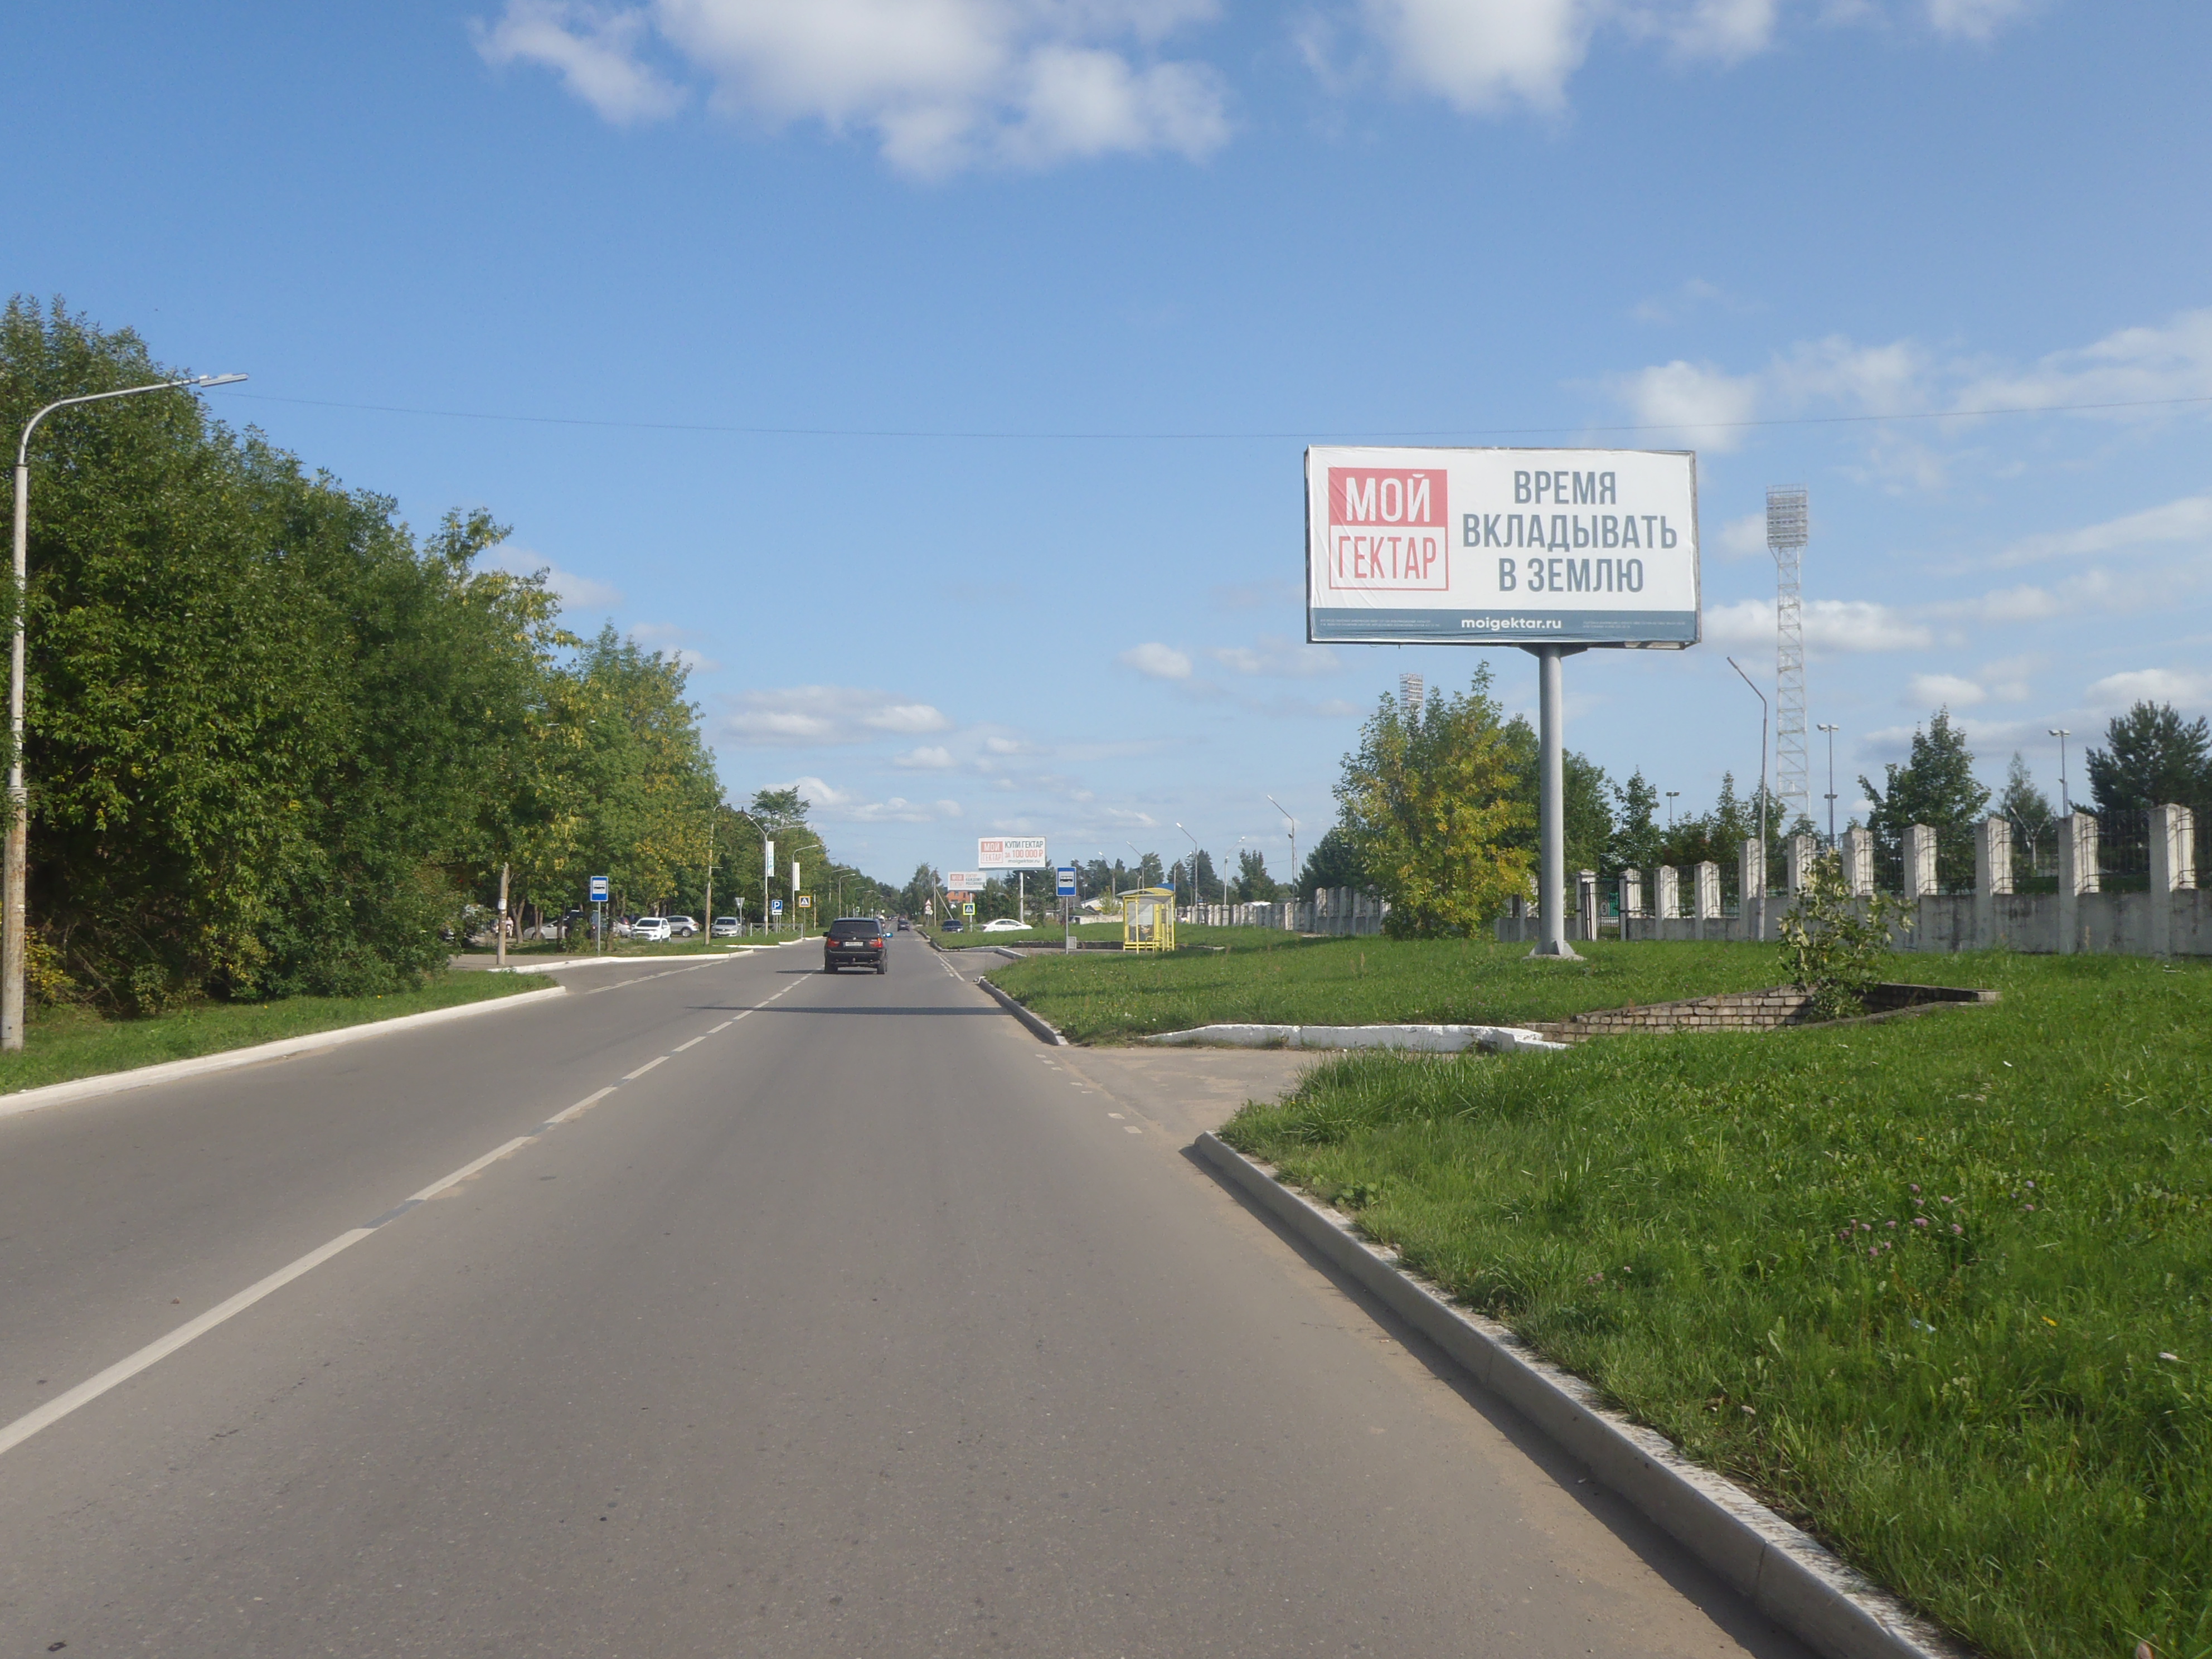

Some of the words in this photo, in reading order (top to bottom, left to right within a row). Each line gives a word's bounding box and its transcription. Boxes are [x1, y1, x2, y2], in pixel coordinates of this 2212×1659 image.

[1346, 474, 1430, 522] МОЙ
[1514, 470, 1616, 505] ВРЕМЯ
[1462, 513, 1677, 552] ВКЛАДЫВАТЬ
[1338, 536, 1437, 579] ГЕКТАР
[1498, 558, 1516, 592] В
[1527, 558, 1643, 593] ЗЕМЛЮ
[1461, 617, 1561, 630] moigektar.ru
[1012, 850, 1023, 858] 100
[1025, 850, 1037, 858] 000
